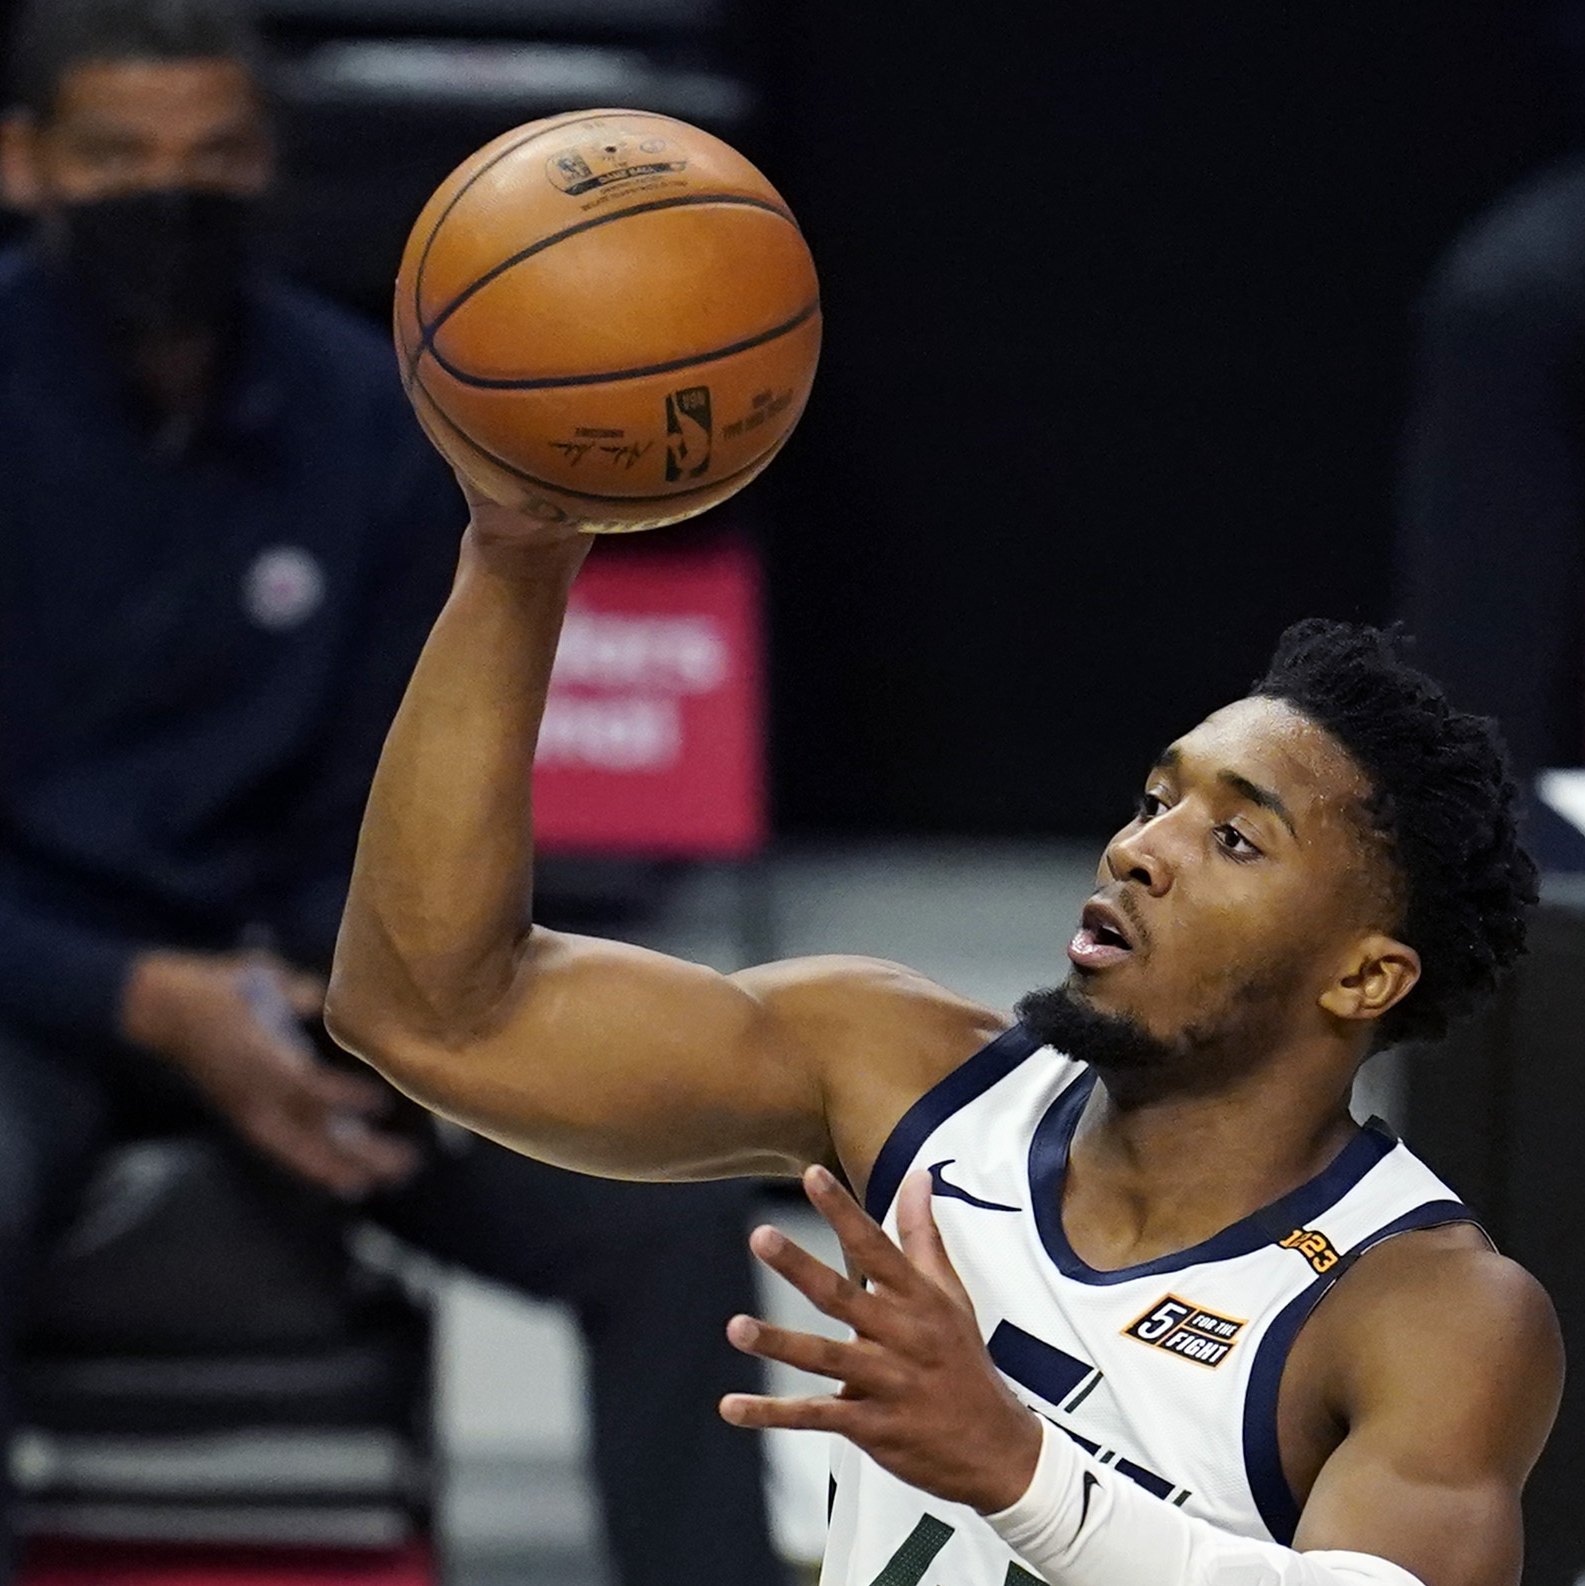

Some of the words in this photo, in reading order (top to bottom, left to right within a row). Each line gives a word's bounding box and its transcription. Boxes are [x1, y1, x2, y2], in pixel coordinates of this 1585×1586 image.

[1137, 1302, 1188, 1339] 5
[1192, 1314, 1218, 1331] FOR
[1214, 1321, 1238, 1337] THE
[1165, 1331, 1229, 1363] FIGHT
